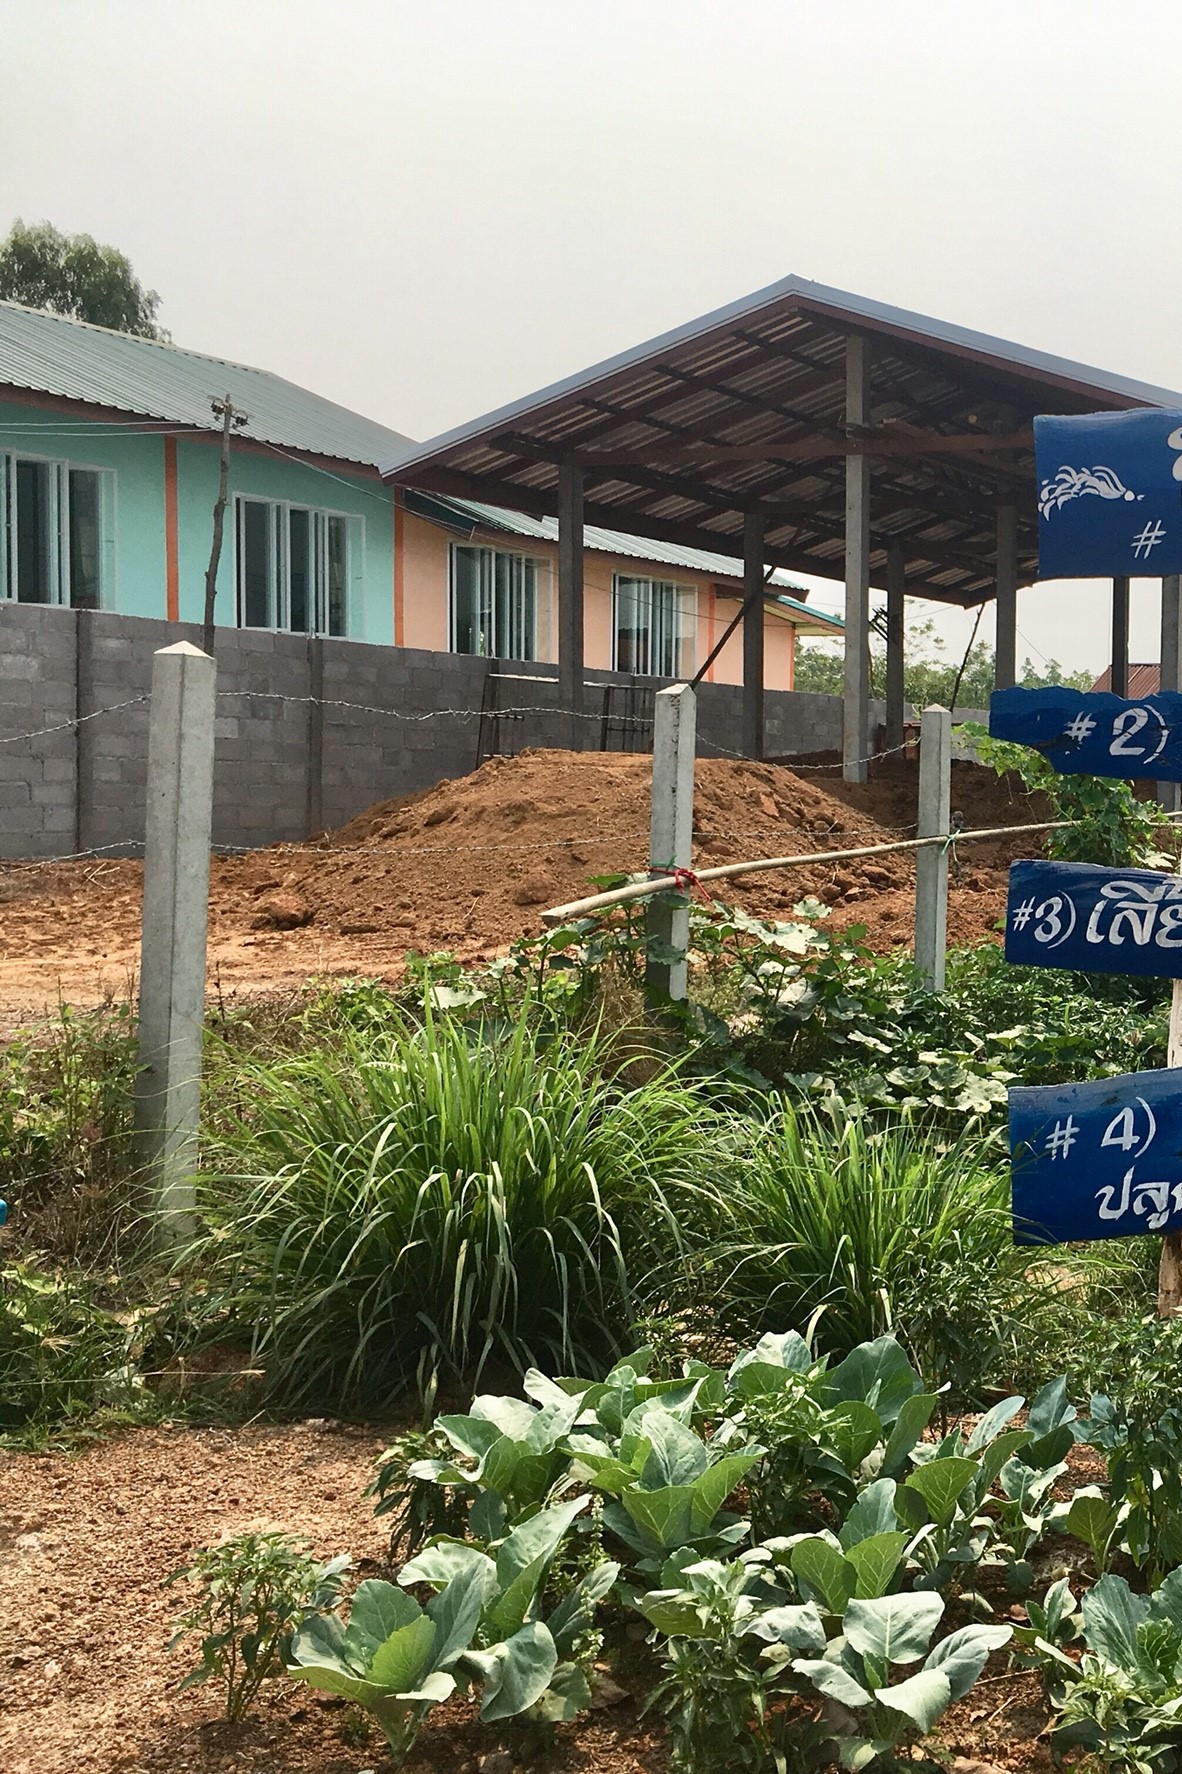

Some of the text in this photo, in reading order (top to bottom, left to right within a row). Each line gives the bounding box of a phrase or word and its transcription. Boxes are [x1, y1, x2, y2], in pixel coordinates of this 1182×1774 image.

[1131, 519, 1167, 560] #
[1064, 711, 1097, 743] #
[1108, 704, 1170, 765] 2)
[1045, 1114, 1081, 1161] #
[1100, 1095, 1157, 1158] 4)
